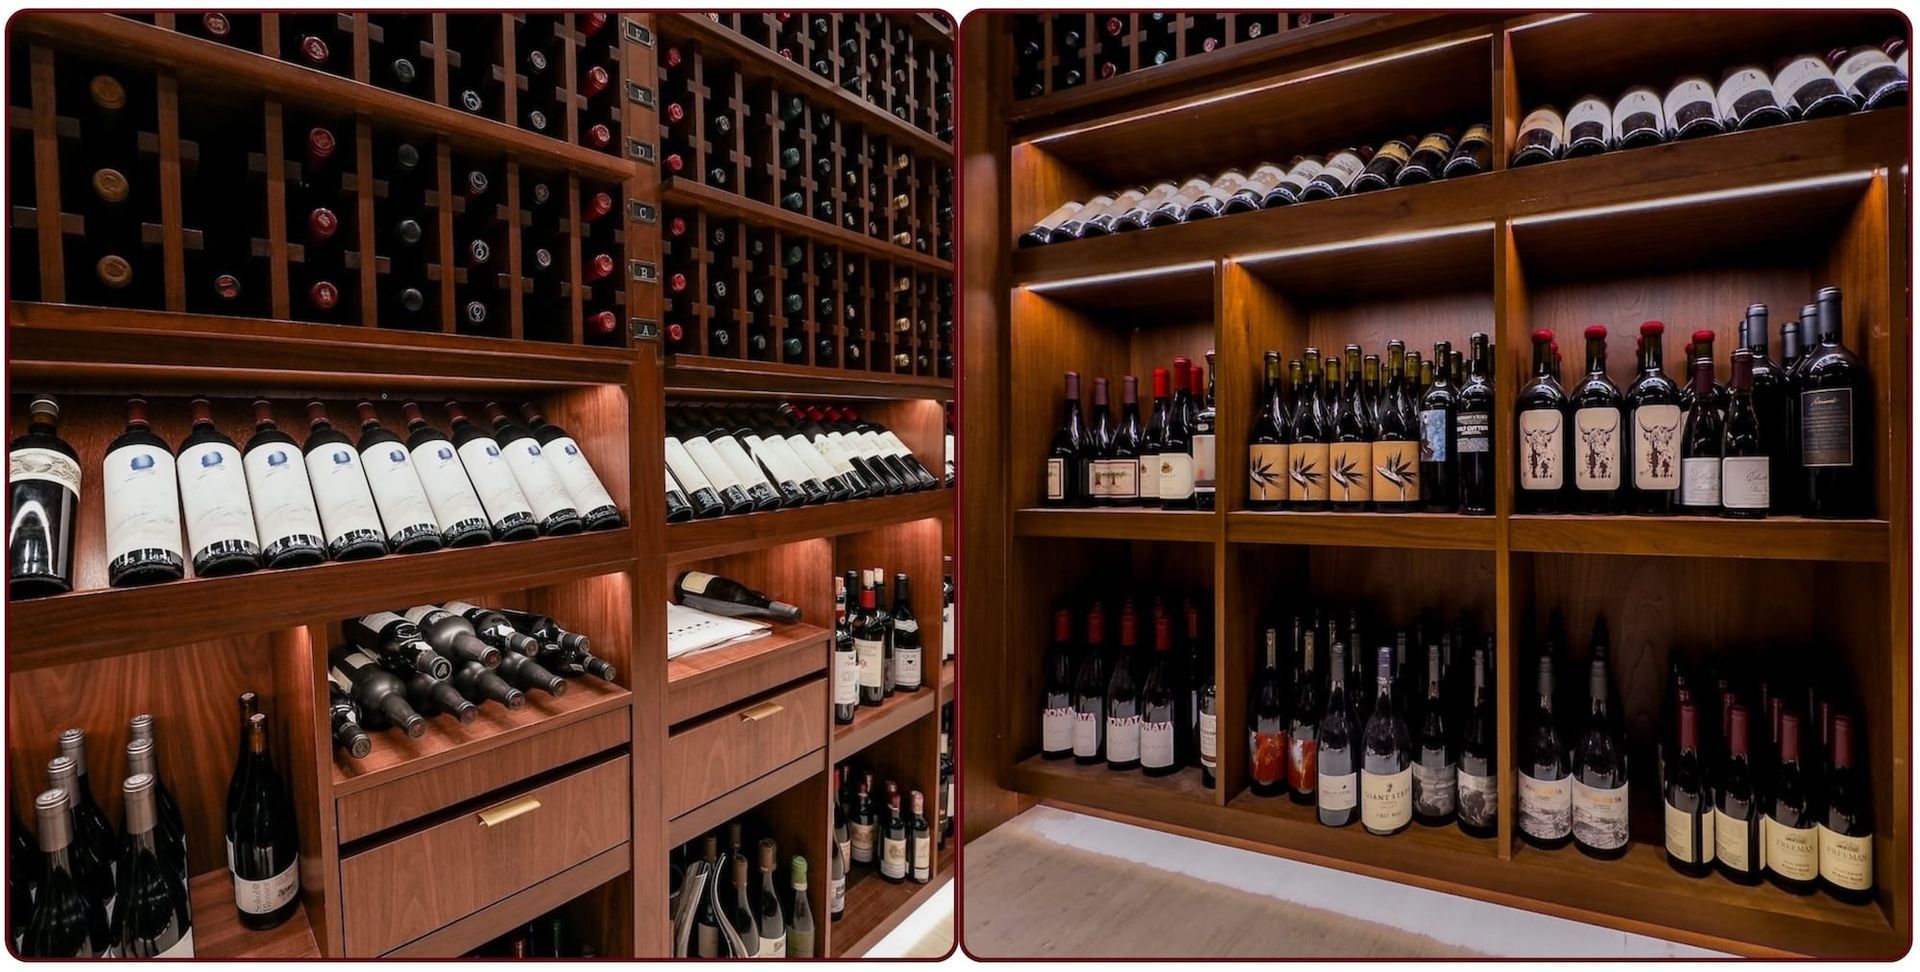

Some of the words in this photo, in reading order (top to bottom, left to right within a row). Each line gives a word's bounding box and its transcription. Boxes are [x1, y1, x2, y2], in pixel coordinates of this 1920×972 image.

[634, 28, 642, 39] F
[637, 146, 645, 158] D
[639, 207, 647, 219] C
[640, 267, 648, 279] B
[641, 325, 650, 337] A
[1365, 791, 1389, 801] GIANT
